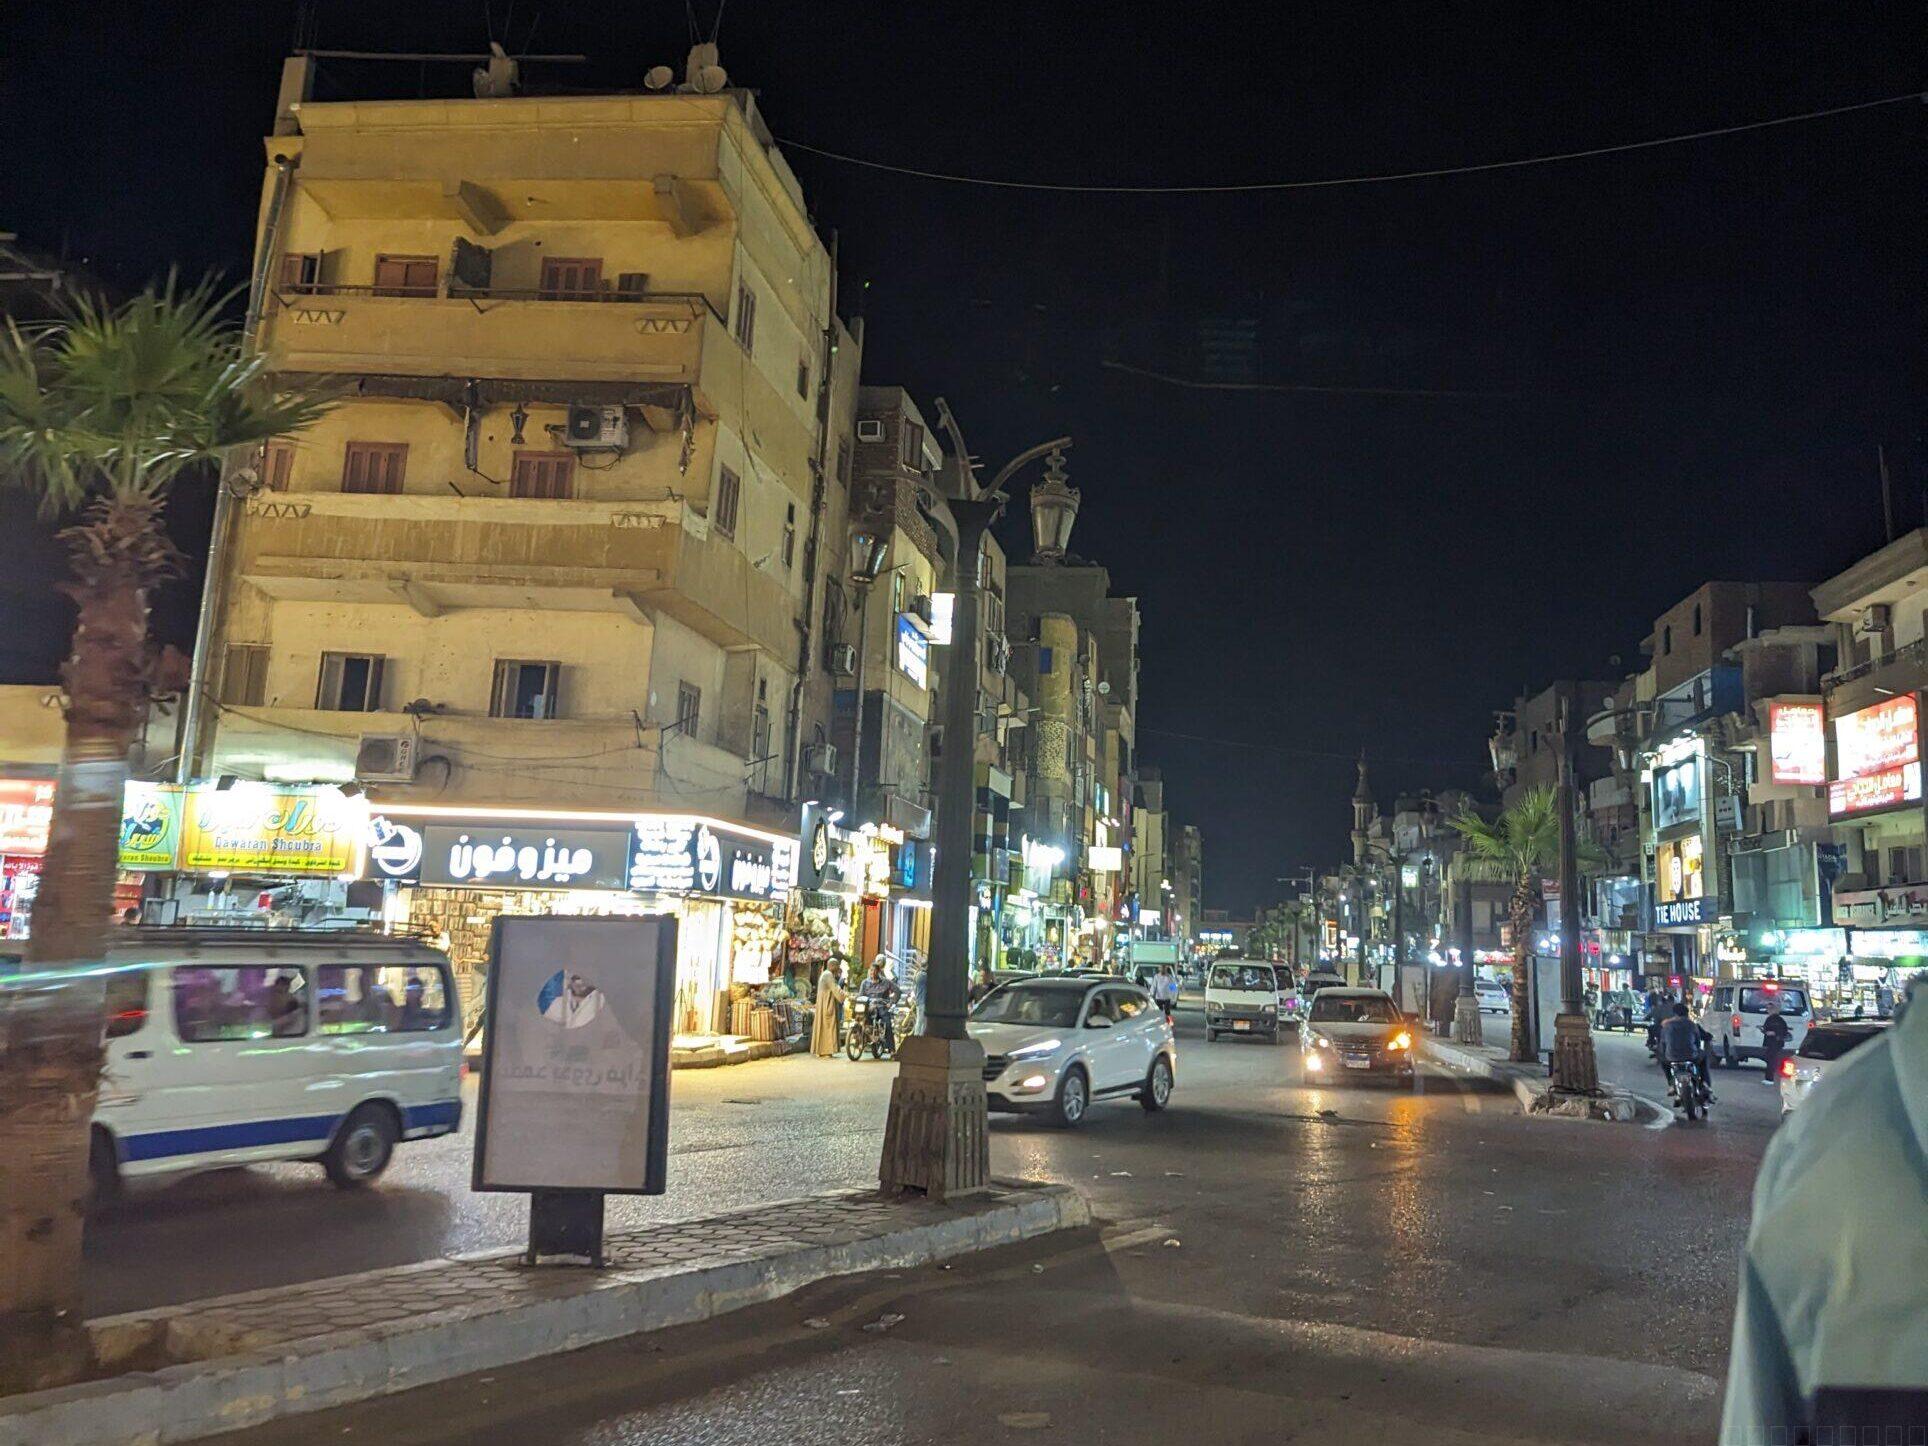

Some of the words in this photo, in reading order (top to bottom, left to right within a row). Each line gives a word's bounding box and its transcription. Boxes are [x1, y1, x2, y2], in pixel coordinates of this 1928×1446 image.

[271, 837, 323, 851] Shoubra
[1655, 905, 1670, 924] TIE
[1670, 900, 1701, 922] HOUSE
